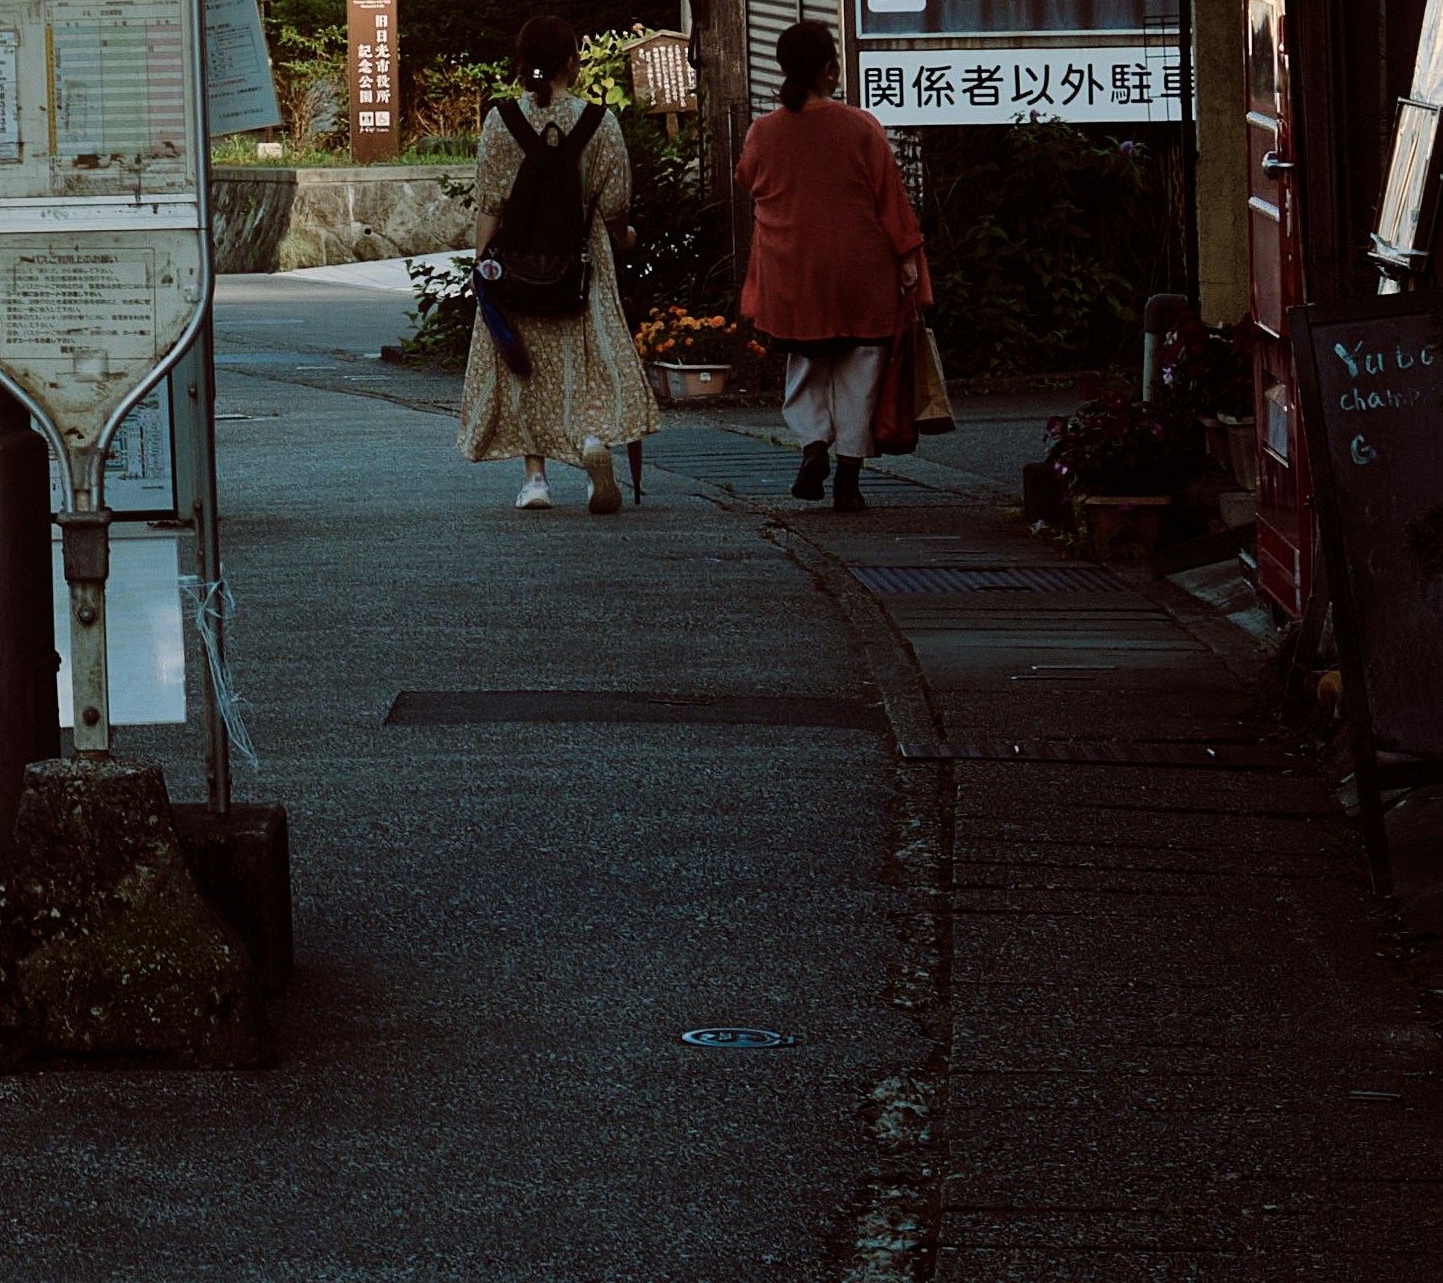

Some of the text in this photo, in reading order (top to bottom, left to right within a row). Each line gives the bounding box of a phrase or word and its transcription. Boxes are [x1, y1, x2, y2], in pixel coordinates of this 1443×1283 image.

[357, 44, 374, 104] 記念公園
[375, 14, 391, 104] 旧日光市役所
